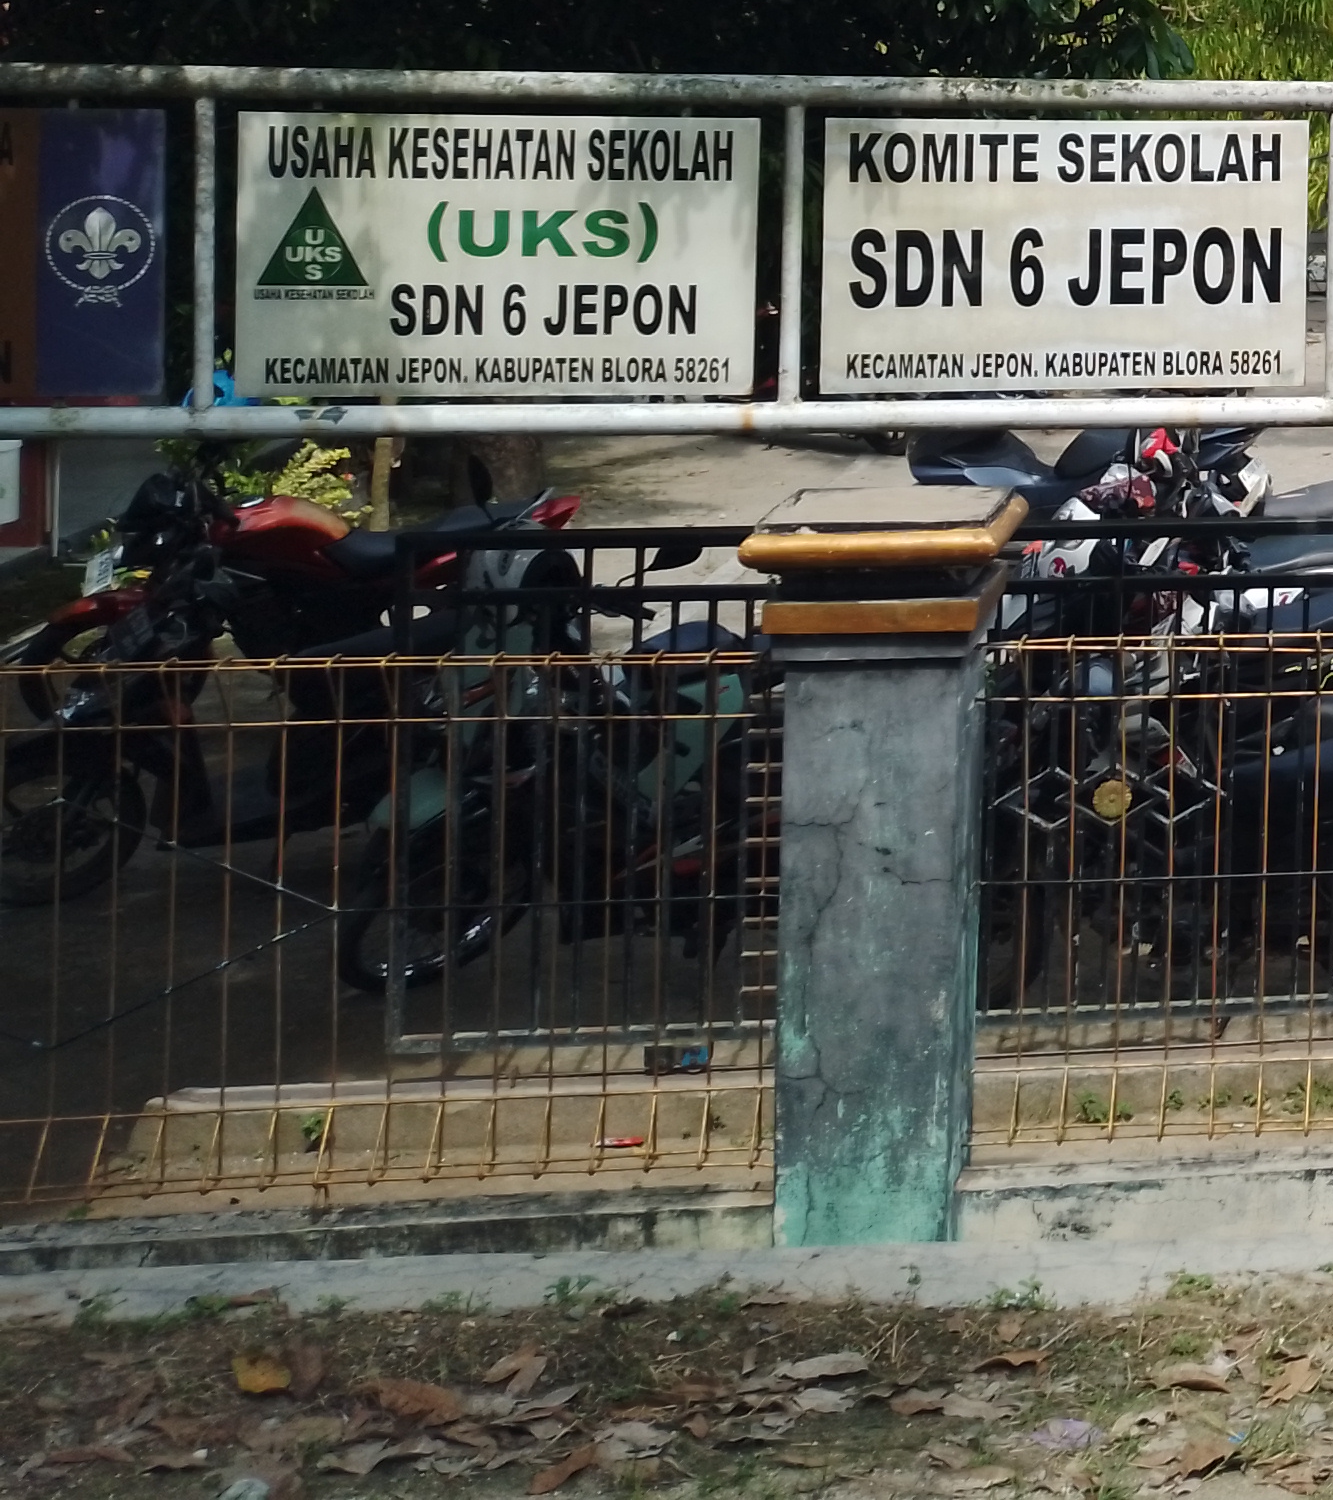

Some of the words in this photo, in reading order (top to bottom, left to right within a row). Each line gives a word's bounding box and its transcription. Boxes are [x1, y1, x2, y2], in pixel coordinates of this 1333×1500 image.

[268, 125, 375, 179] USAHA
[388, 127, 575, 180] KESEHATAN
[587, 129, 733, 181] SEKOLAH
[848, 132, 1039, 183] KOMITE
[1057, 133, 1281, 182] SEKOLAH
[285, 246, 342, 262] UKS
[427, 201, 658, 262] (UKS)
[848, 228, 984, 308] SDN
[1009, 227, 1044, 307] 6
[1067, 226, 1282, 306] JEPON
[390, 284, 484, 336] SDN
[502, 284, 527, 336] 6
[543, 284, 697, 336] JEPON
[265, 358, 389, 384] KECAMATAN
[395, 358, 468, 383] JEPON.
[475, 358, 594, 383] KABUPATEN
[601, 358, 667, 383] BLORA
[673, 358, 730, 383] 58261
[846, 353, 964, 379] KECAMATAN
[970, 352, 1038, 378] JEPON.
[1045, 351, 1156, 377] KABUPATEN
[1163, 350, 1223, 375] BLORA
[1230, 349, 1281, 375] 58261
